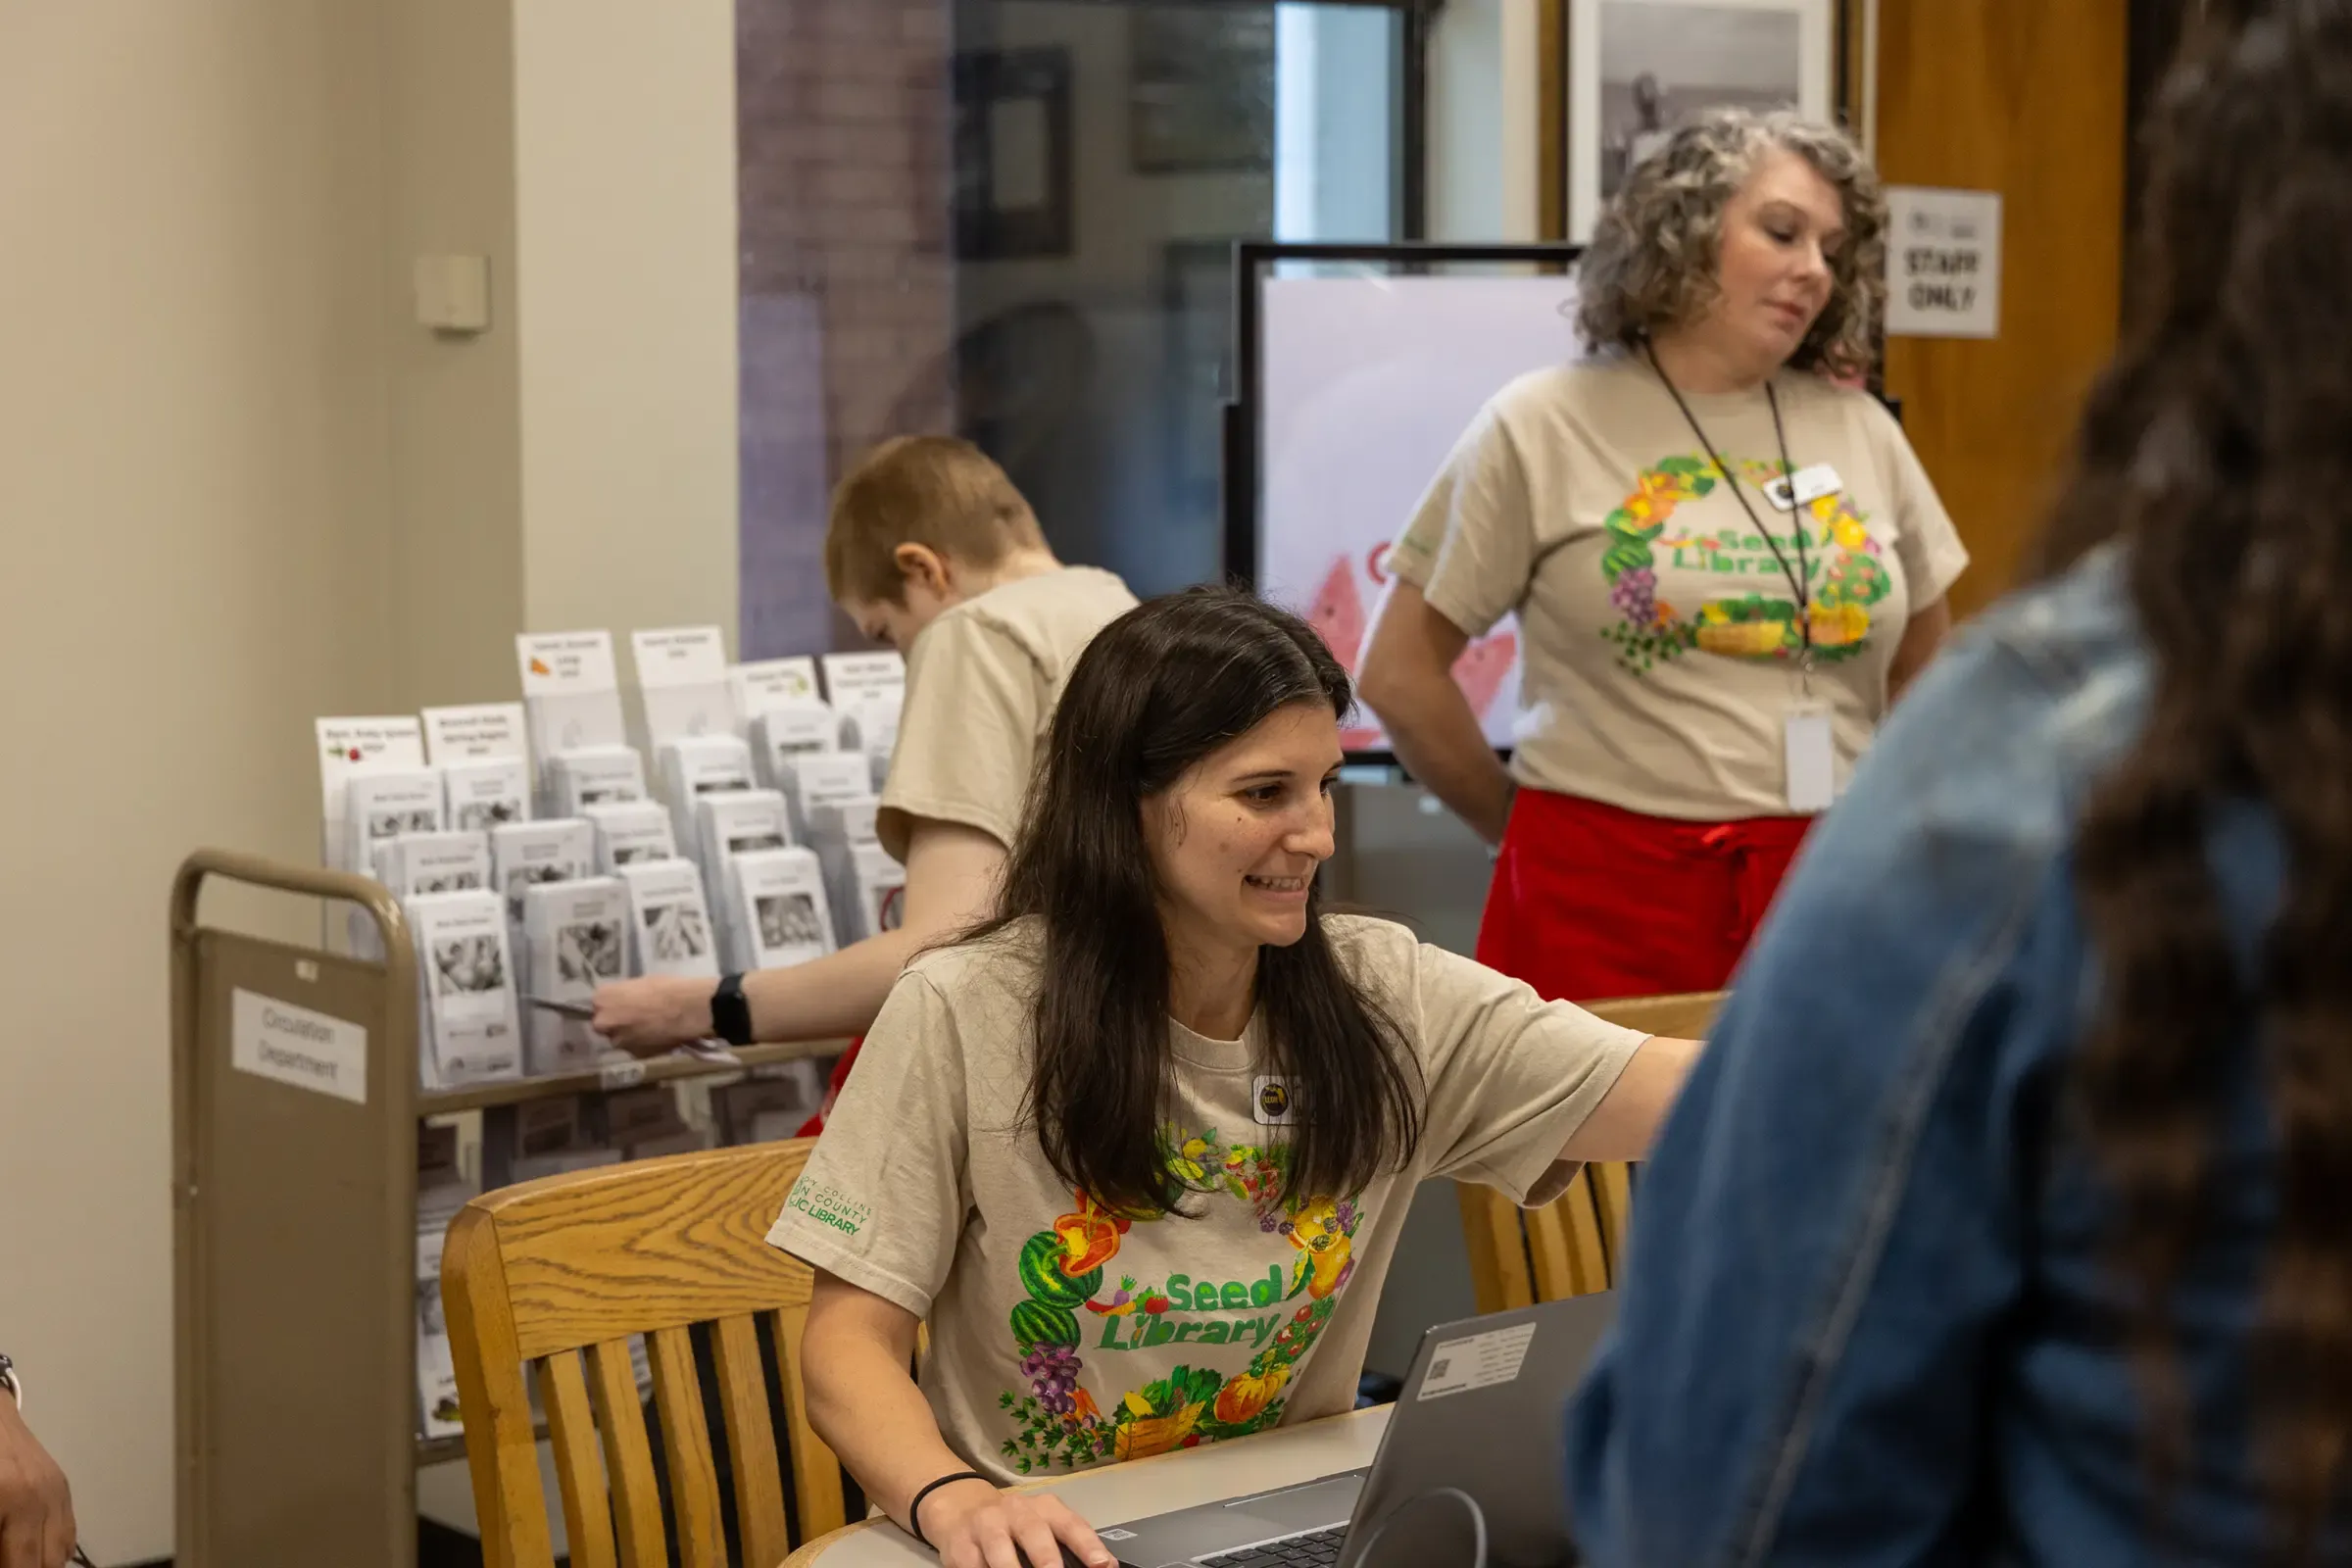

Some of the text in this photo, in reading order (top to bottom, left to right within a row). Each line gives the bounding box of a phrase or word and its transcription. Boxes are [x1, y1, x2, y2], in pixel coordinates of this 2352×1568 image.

[1904, 247, 1979, 276] STAFF
[1907, 281, 1976, 312] ONLY
[1718, 528, 1813, 551] Seed
[808, 1204, 860, 1236] LIBRARY
[815, 1194, 867, 1224] COUNTY
[1165, 1264, 1282, 1310] Seed
[1097, 1313, 1281, 1350] Library
